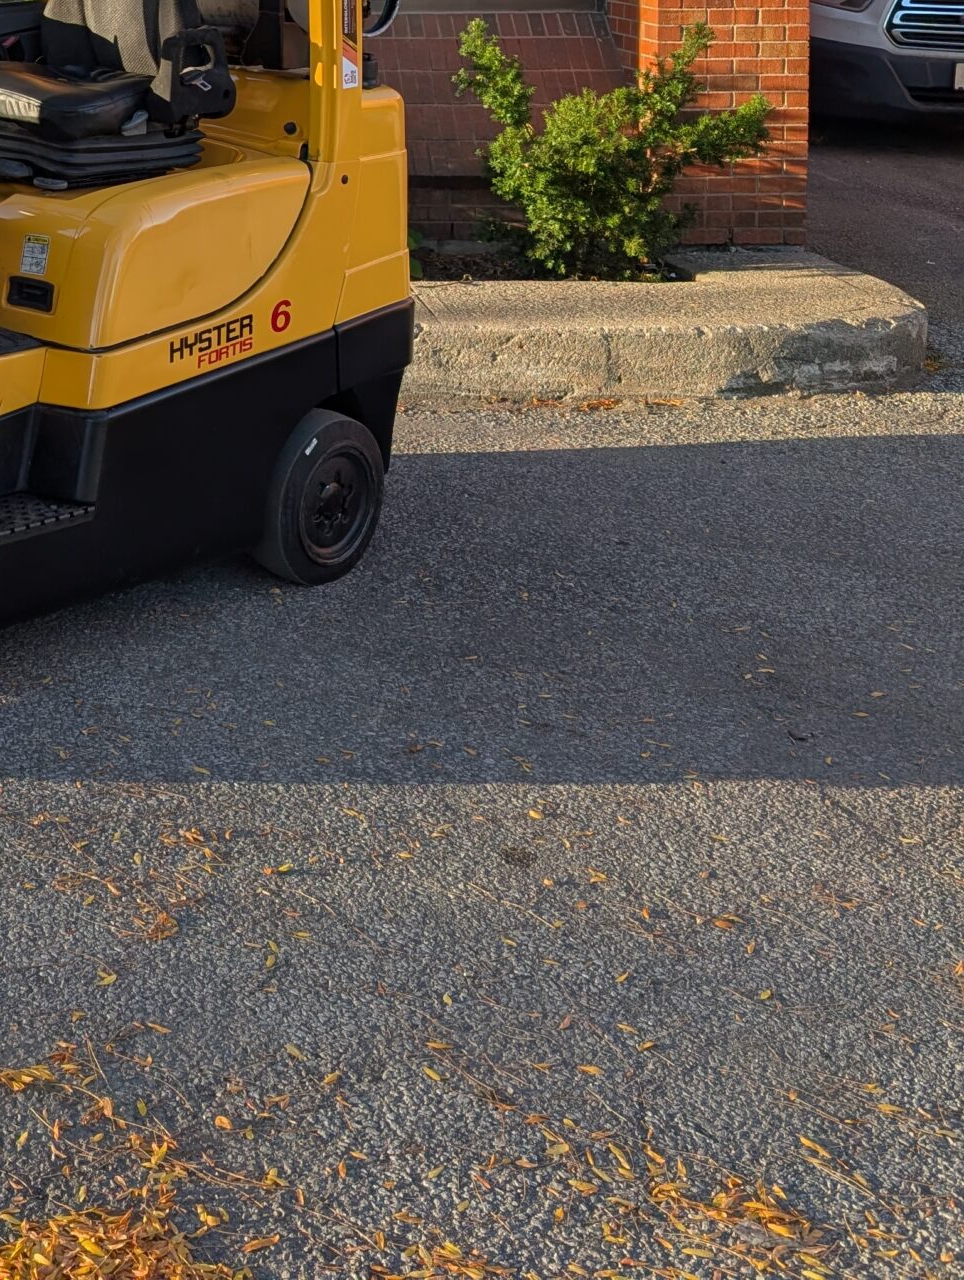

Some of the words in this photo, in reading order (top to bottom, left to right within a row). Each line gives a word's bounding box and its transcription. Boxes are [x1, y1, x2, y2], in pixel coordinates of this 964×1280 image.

[270, 299, 292, 333] 6
[169, 313, 253, 363] HYSTER
[197, 336, 253, 369] FORTIS
